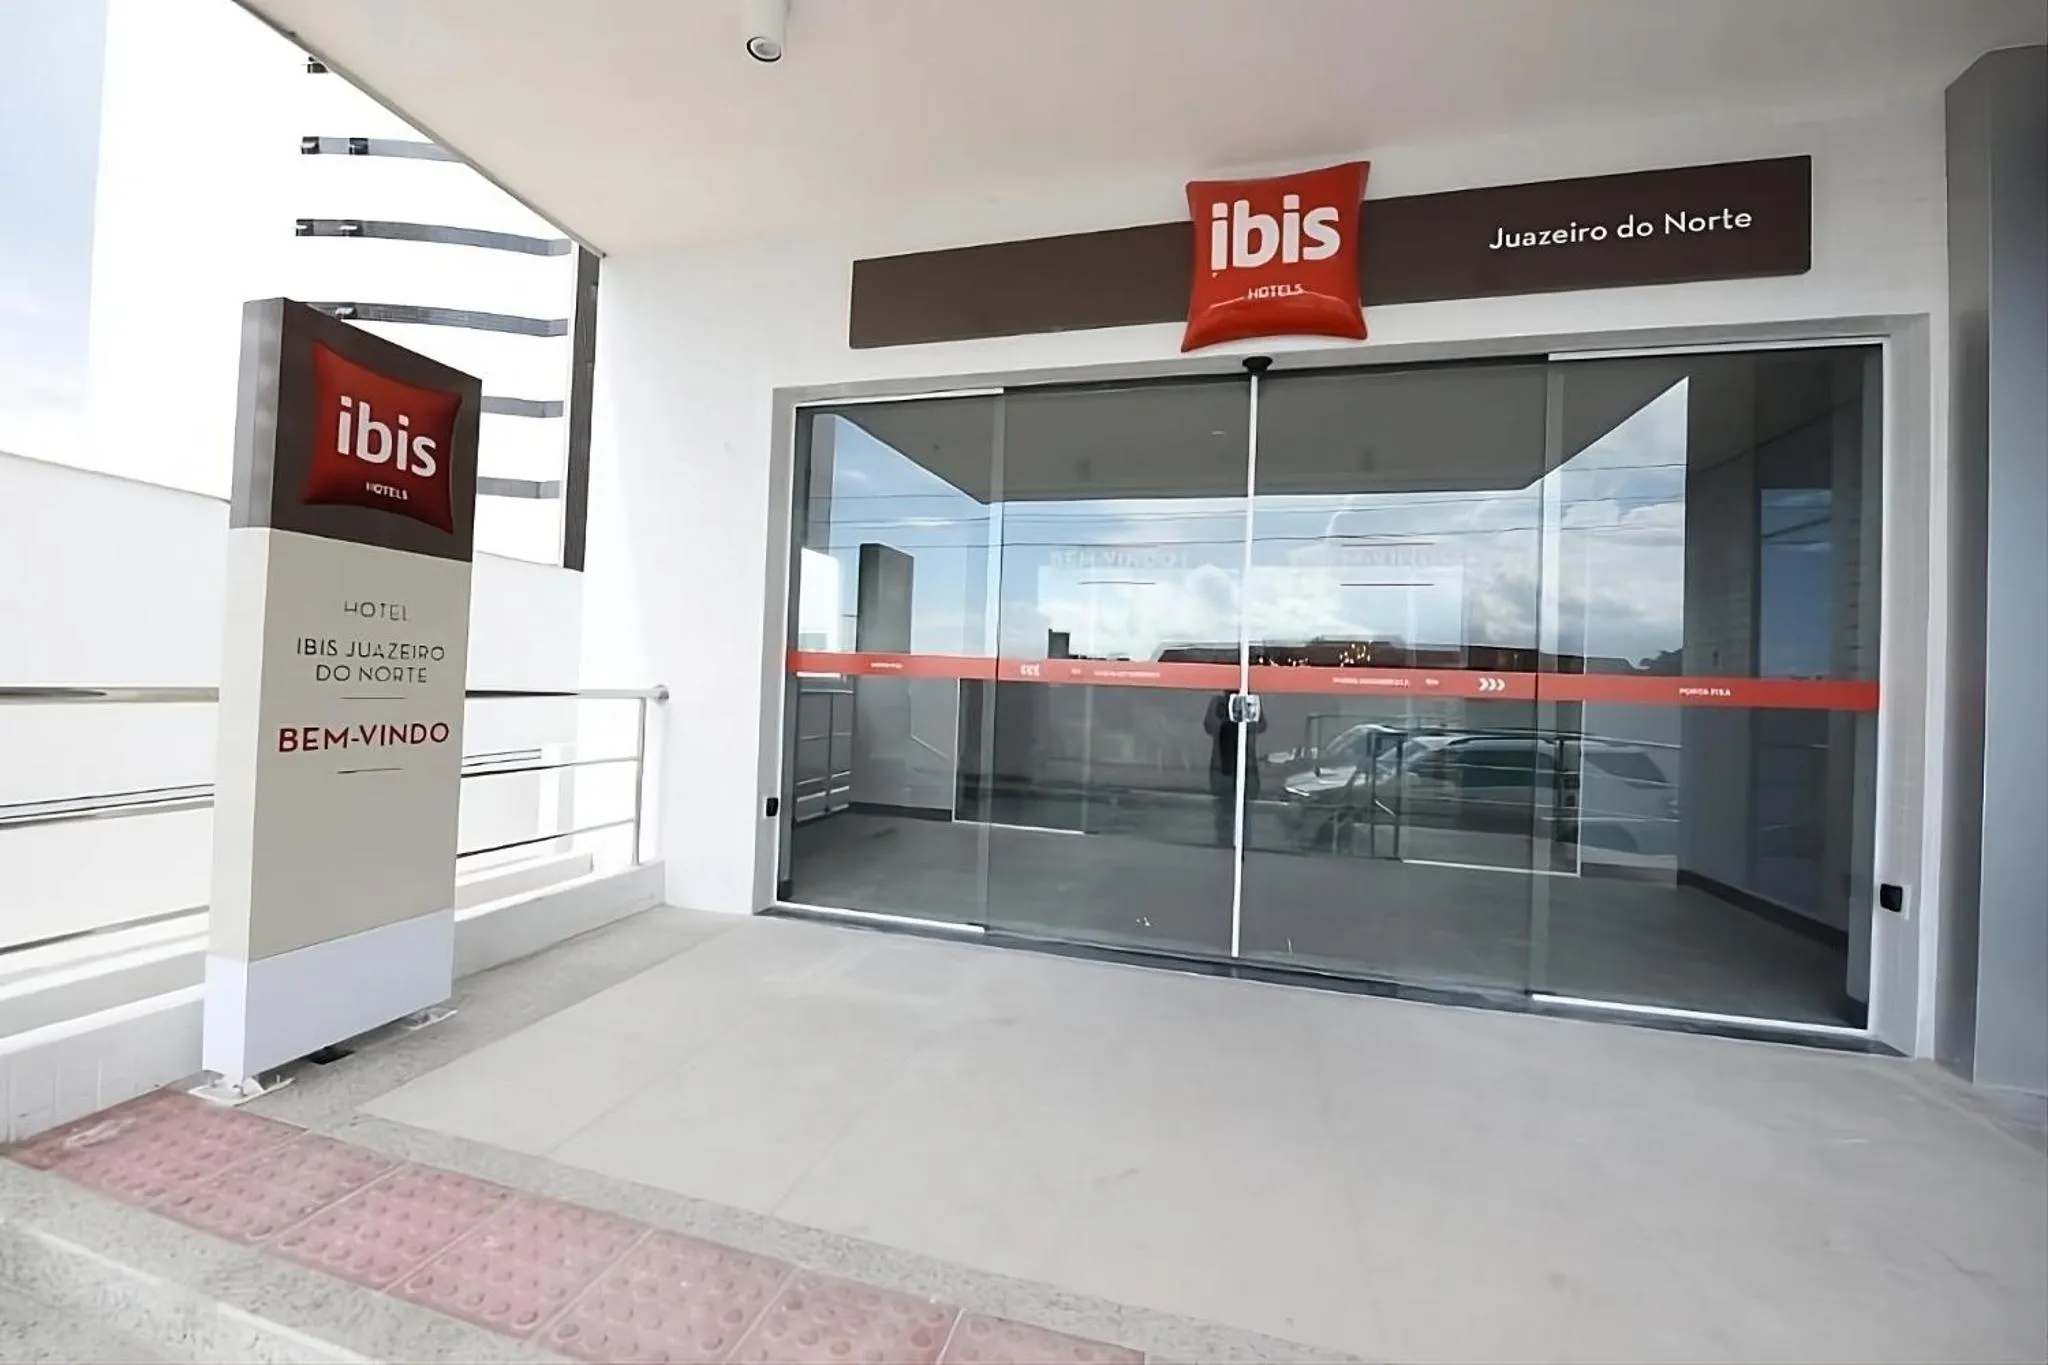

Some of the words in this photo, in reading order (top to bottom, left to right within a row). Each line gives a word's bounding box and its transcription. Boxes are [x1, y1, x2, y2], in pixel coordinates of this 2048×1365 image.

[1211, 194, 1341, 270] ibis
[1489, 222, 1608, 249] Juazeiro
[1617, 214, 1653, 238] do
[1665, 208, 1753, 234] Norte
[1247, 284, 1303, 300] HOTELS
[337, 395, 437, 477] ibis
[365, 481, 408, 500] HOTELS
[344, 600, 408, 622] HOTEL
[297, 637, 338, 656] IBIS
[346, 641, 445, 662] JUAZEIRO
[316, 664, 351, 682] DO
[359, 666, 428, 684] NORTE
[279, 722, 450, 752] BEM-VINDO
